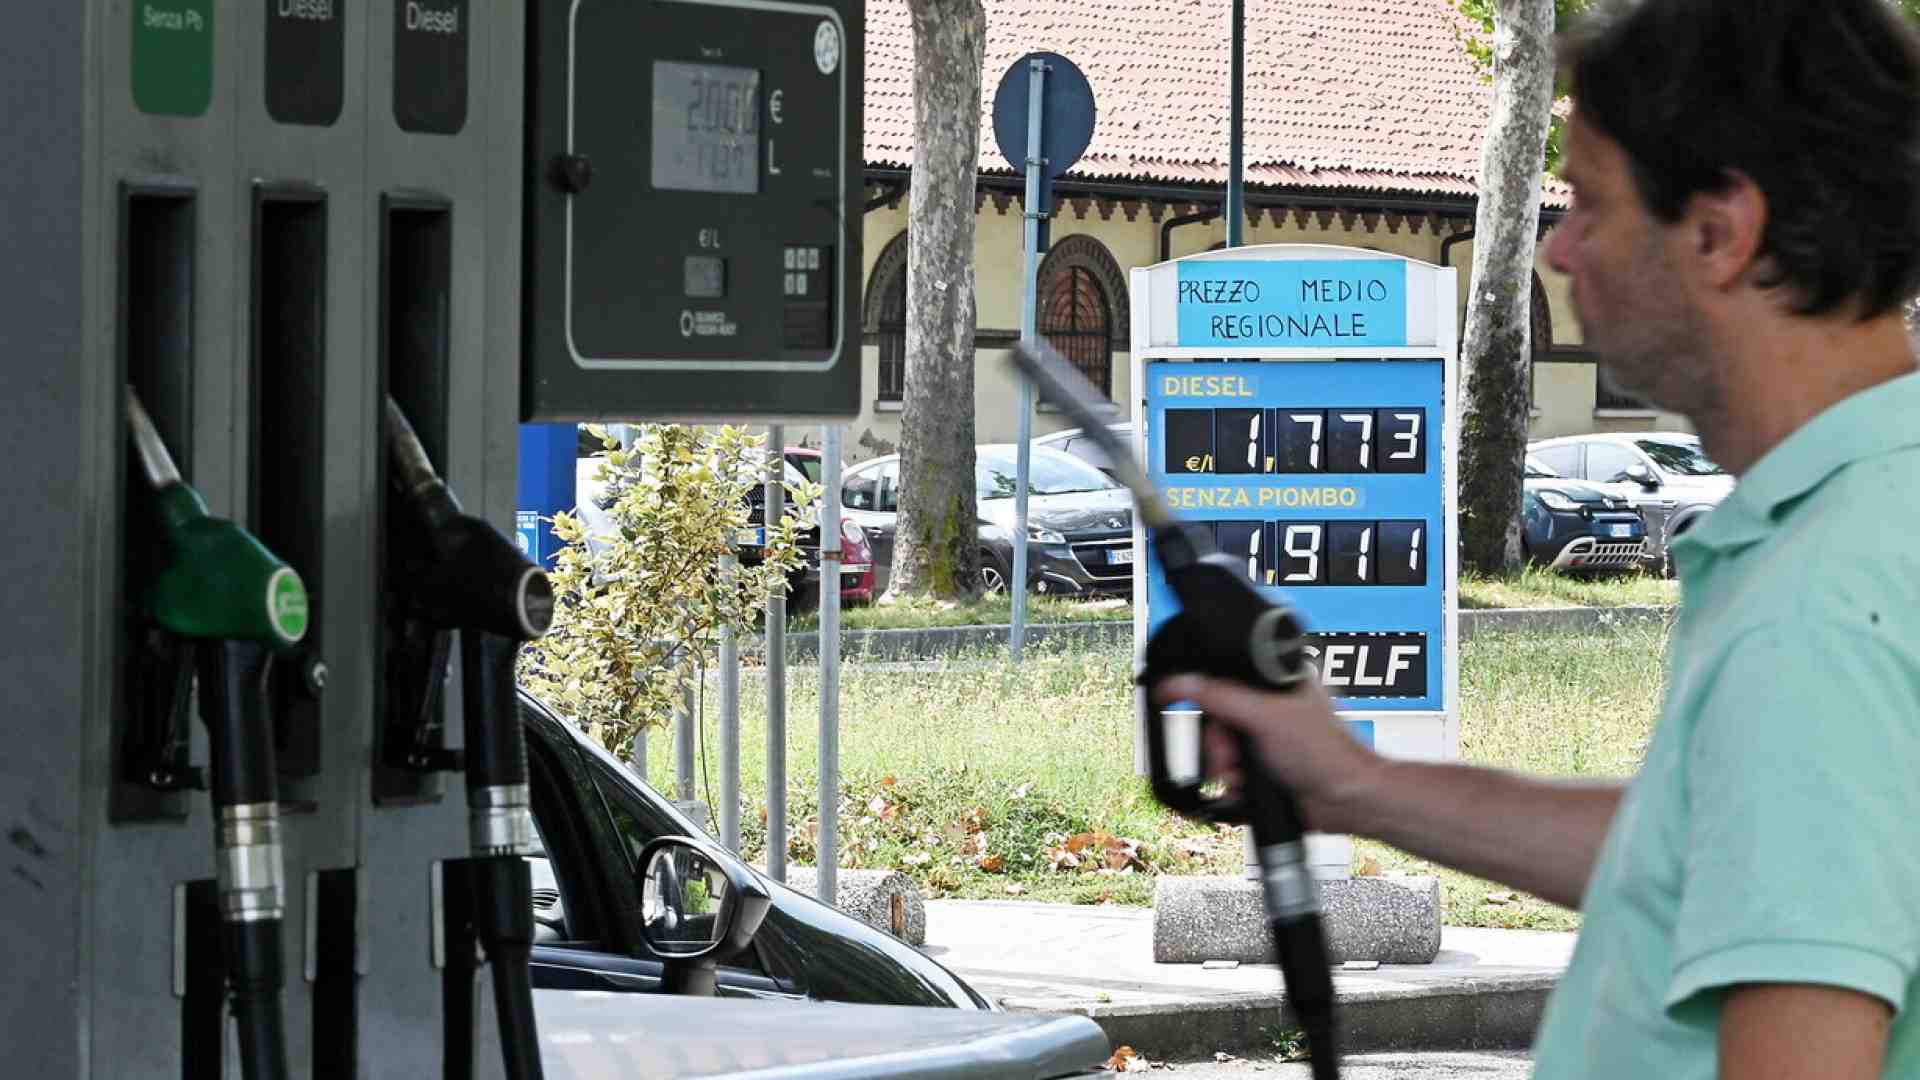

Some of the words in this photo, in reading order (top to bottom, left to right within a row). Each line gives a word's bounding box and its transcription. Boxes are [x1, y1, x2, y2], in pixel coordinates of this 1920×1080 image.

[144, 7, 182, 30] Senza
[186, 9, 203, 31] Pb
[279, 0, 333, 20] Diesel
[405, 2, 457, 32] Diesel
[1178, 279, 1260, 303] PREZZO
[1302, 279, 1387, 302] MEDIO
[1211, 313, 1368, 338] REGIONALE
[1164, 376, 1253, 396] DIESEL
[1166, 487, 1249, 507] SENZA
[1259, 487, 1357, 507] PIOMBO
